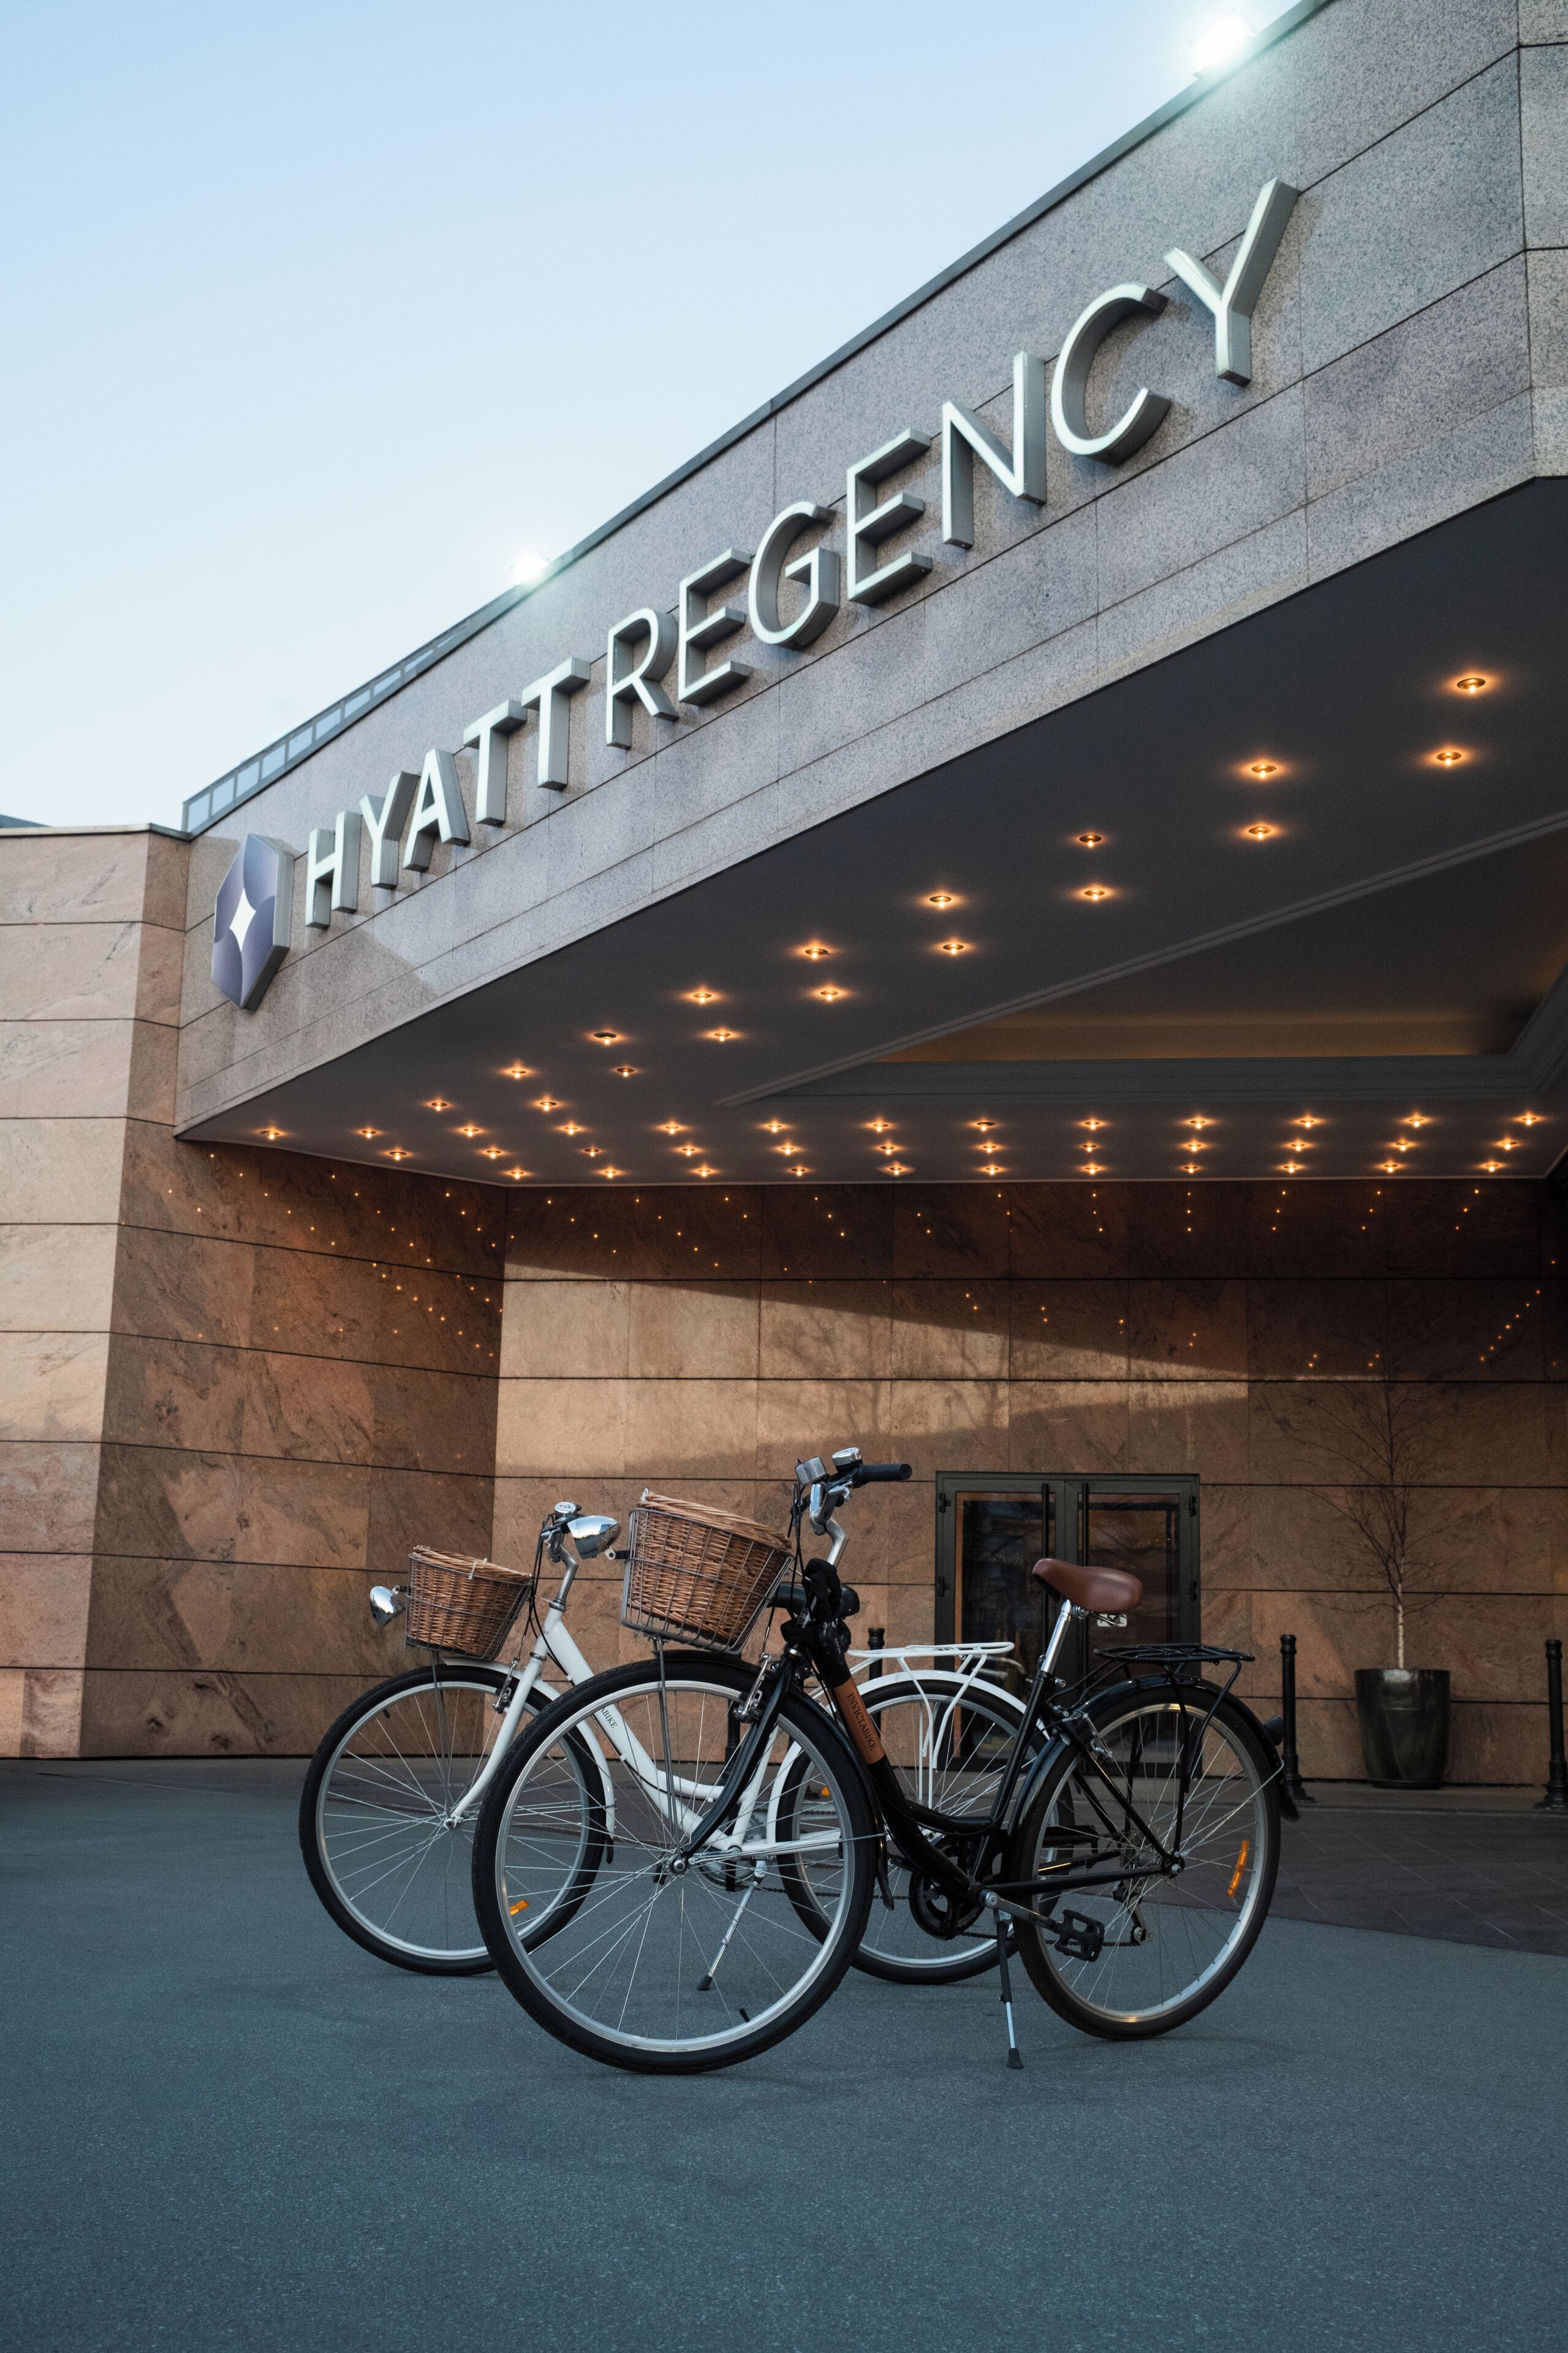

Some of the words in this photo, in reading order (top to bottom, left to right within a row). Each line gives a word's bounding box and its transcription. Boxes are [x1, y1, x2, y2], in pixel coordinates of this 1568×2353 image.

[305, 657, 590, 928] HYATT
[606, 178, 1300, 749] REGENCY
[847, 1692, 877, 1751] INVICTABIKE
